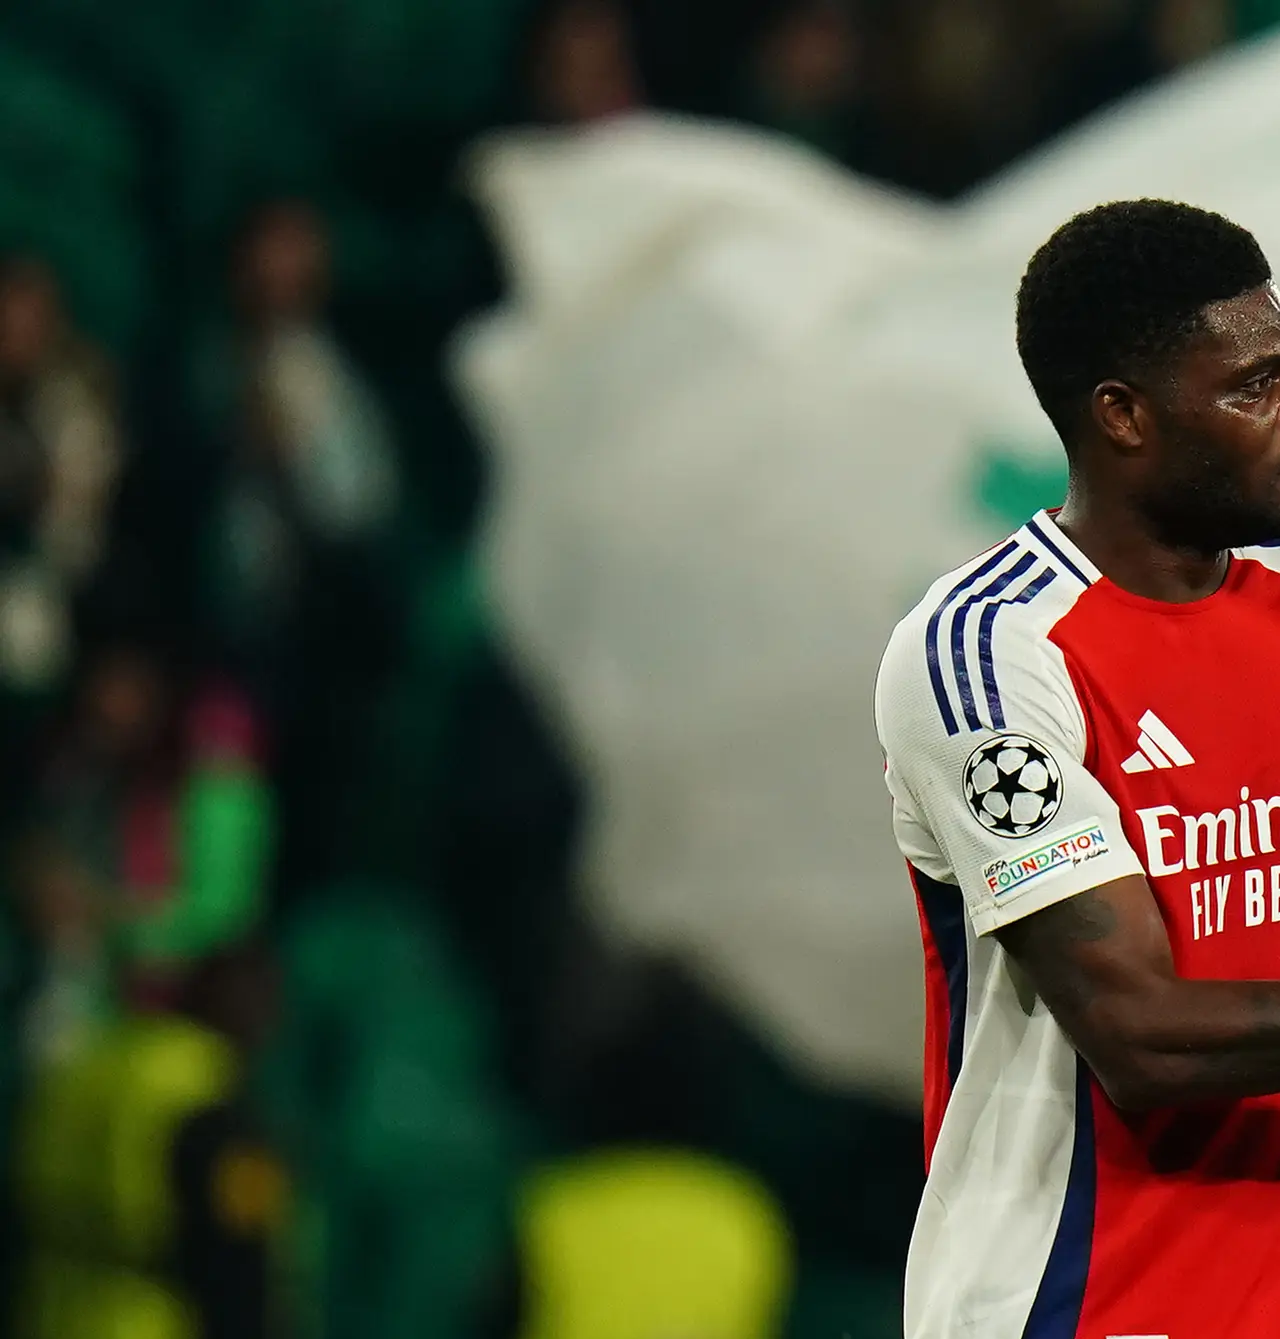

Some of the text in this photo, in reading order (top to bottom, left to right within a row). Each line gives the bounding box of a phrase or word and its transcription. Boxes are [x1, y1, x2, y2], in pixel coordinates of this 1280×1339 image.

[984, 859, 1008, 878] UEFA
[987, 830, 1105, 892] FOUNDATION
[1190, 874, 1231, 940] FLY
